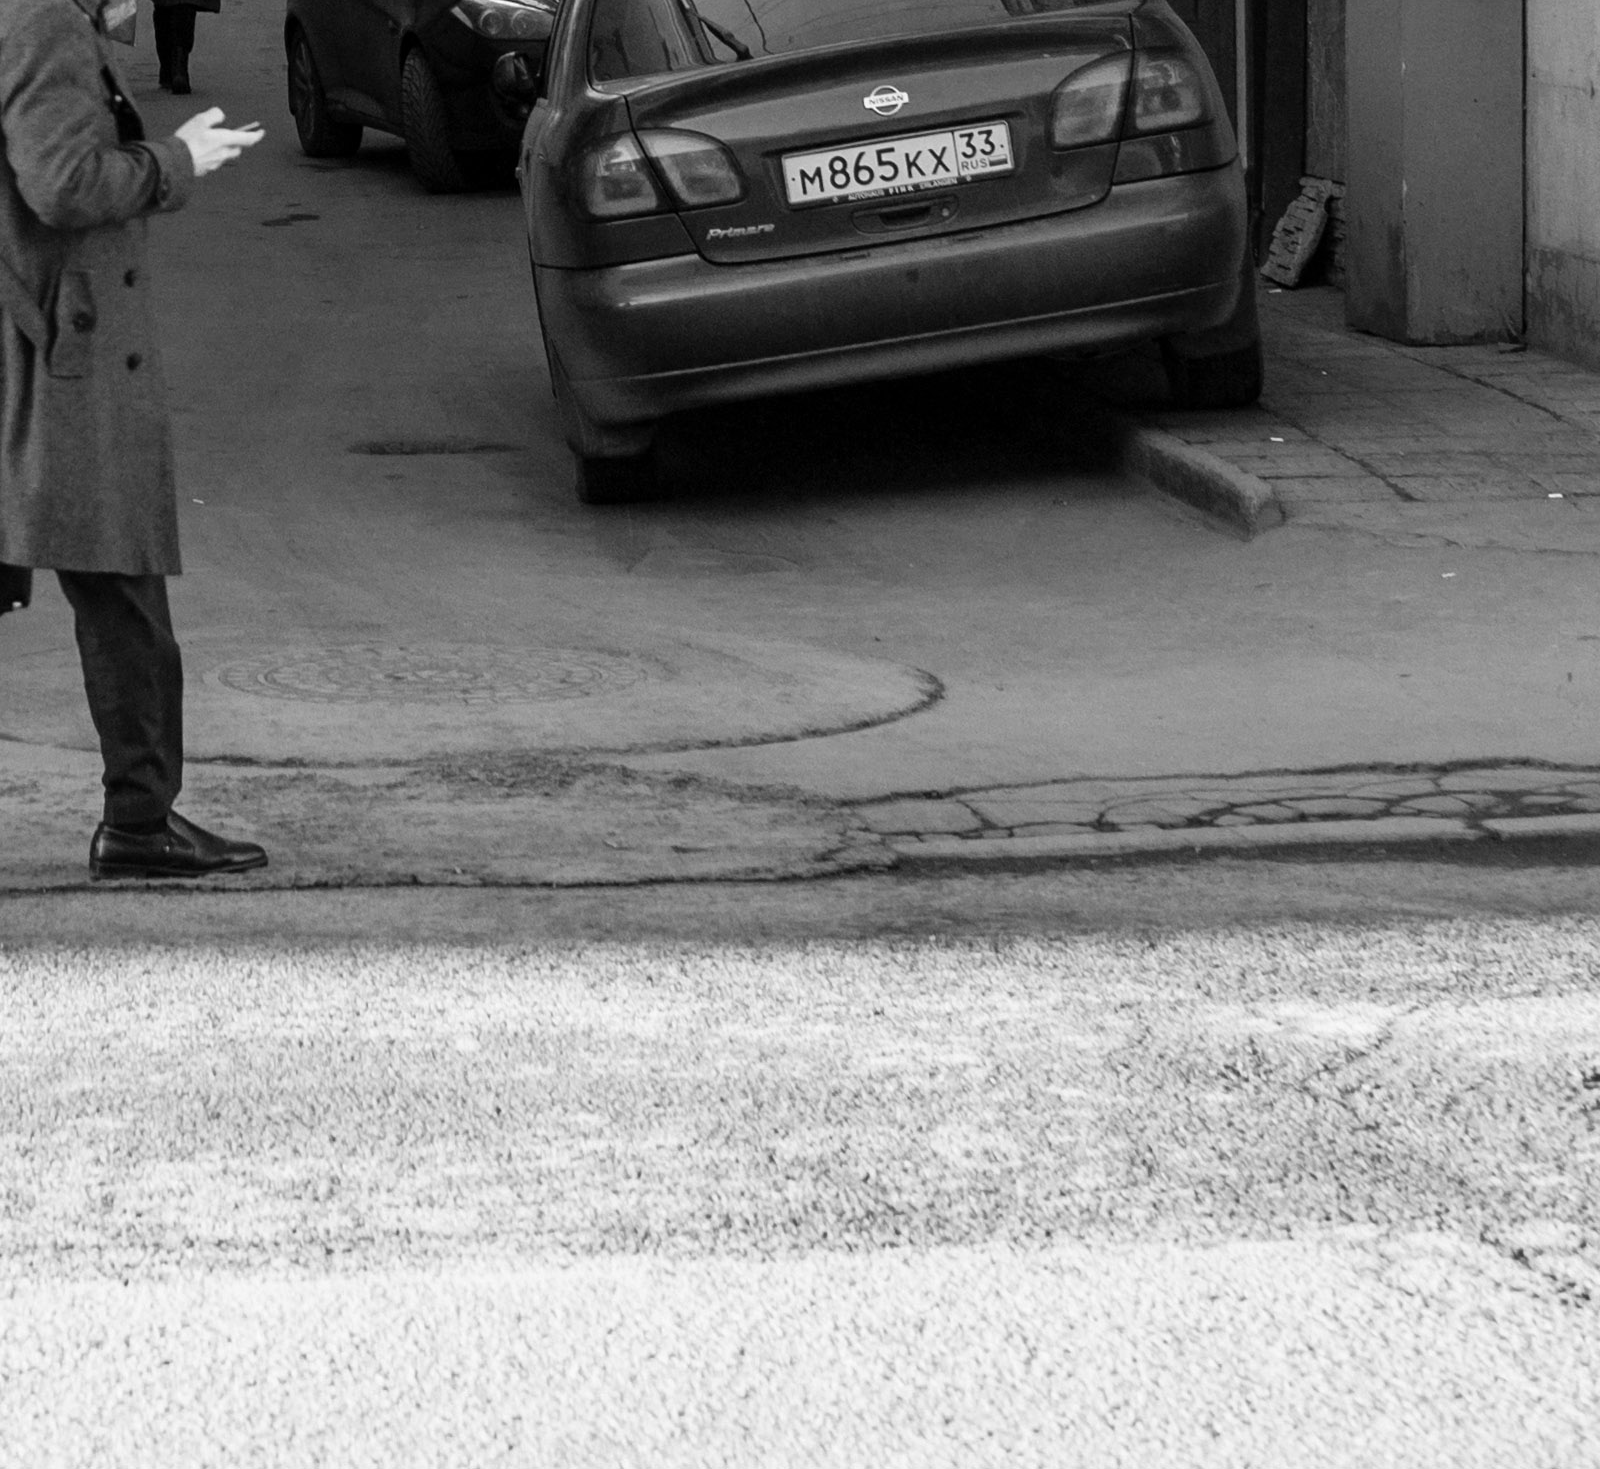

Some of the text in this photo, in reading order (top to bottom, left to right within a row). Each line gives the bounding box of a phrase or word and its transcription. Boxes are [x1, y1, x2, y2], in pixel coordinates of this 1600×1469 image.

[868, 94, 904, 105] NISSAN
[958, 129, 996, 158] 33
[961, 158, 988, 172] RUS
